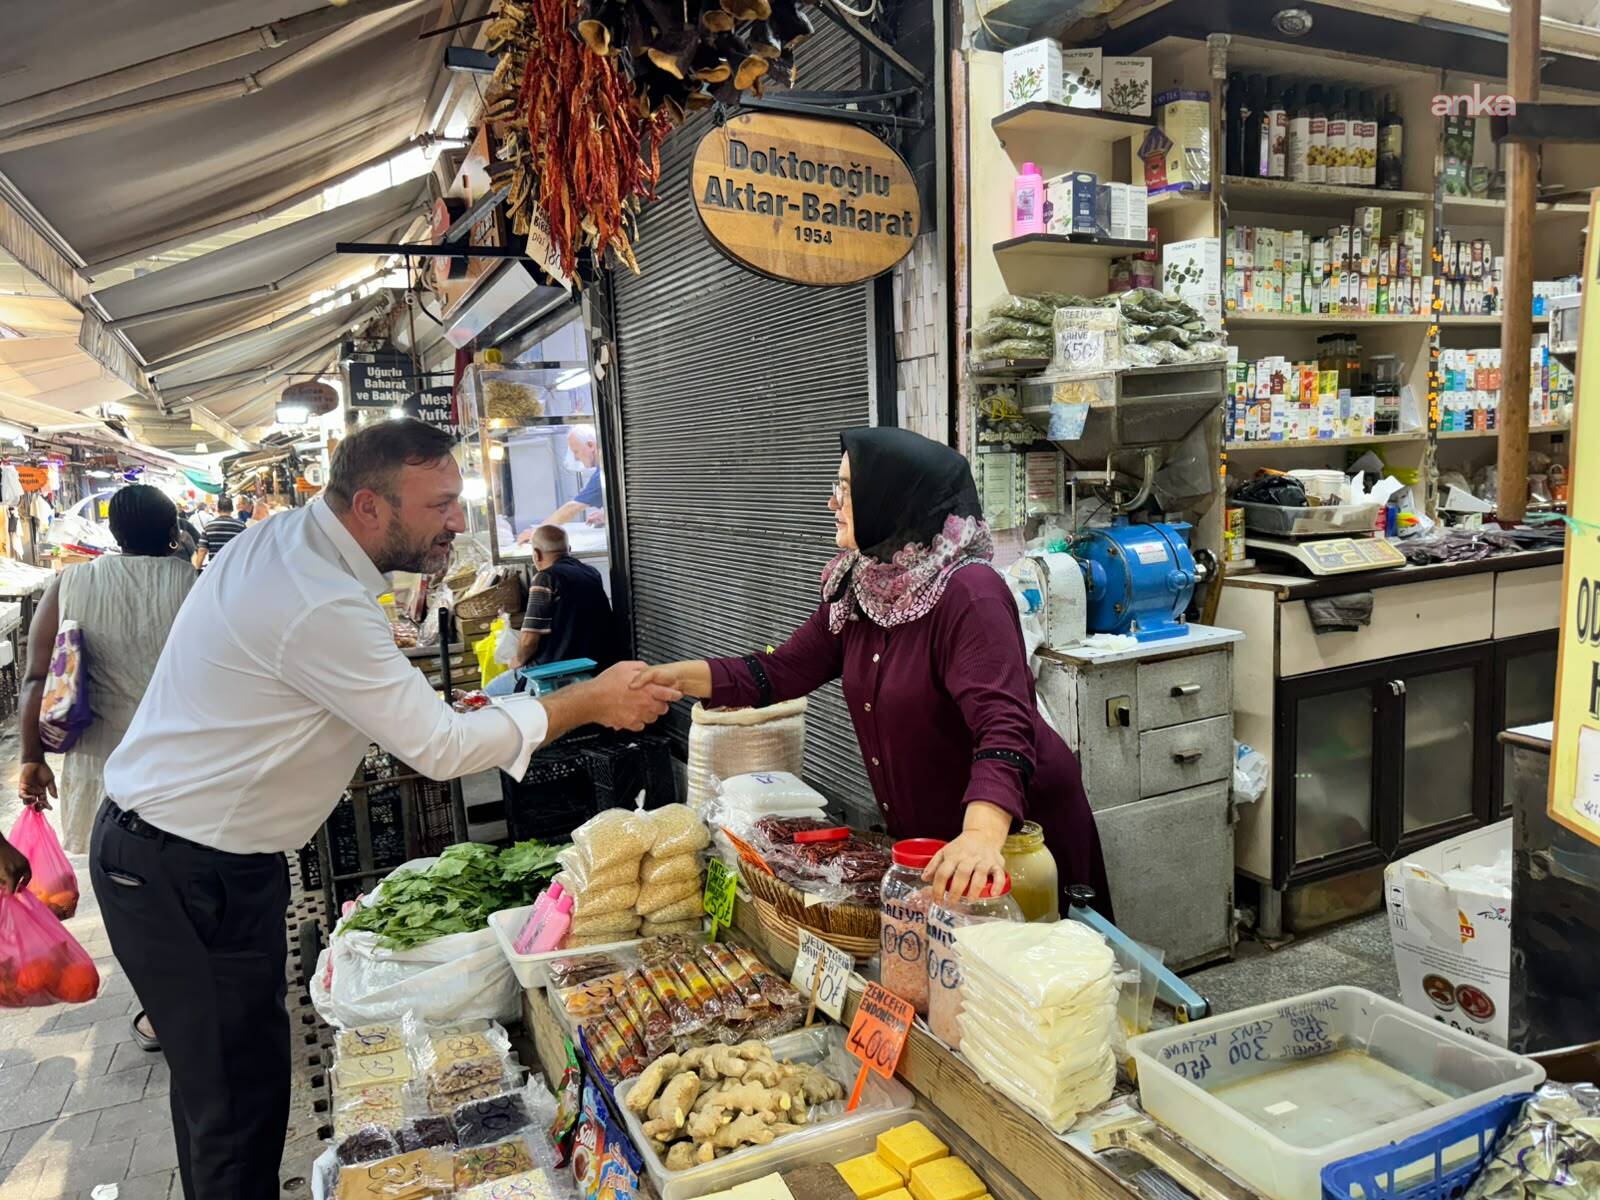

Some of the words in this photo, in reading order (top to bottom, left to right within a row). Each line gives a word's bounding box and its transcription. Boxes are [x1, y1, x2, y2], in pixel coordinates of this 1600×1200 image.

[729, 139, 890, 198] Doktoroğlu
[703, 175, 914, 238] Aktar-Baharat
[794, 225, 833, 245] 1954
[367, 366, 402, 378] Uğurlu
[364, 378, 406, 389] Baharat
[356, 391, 370, 401] ve
